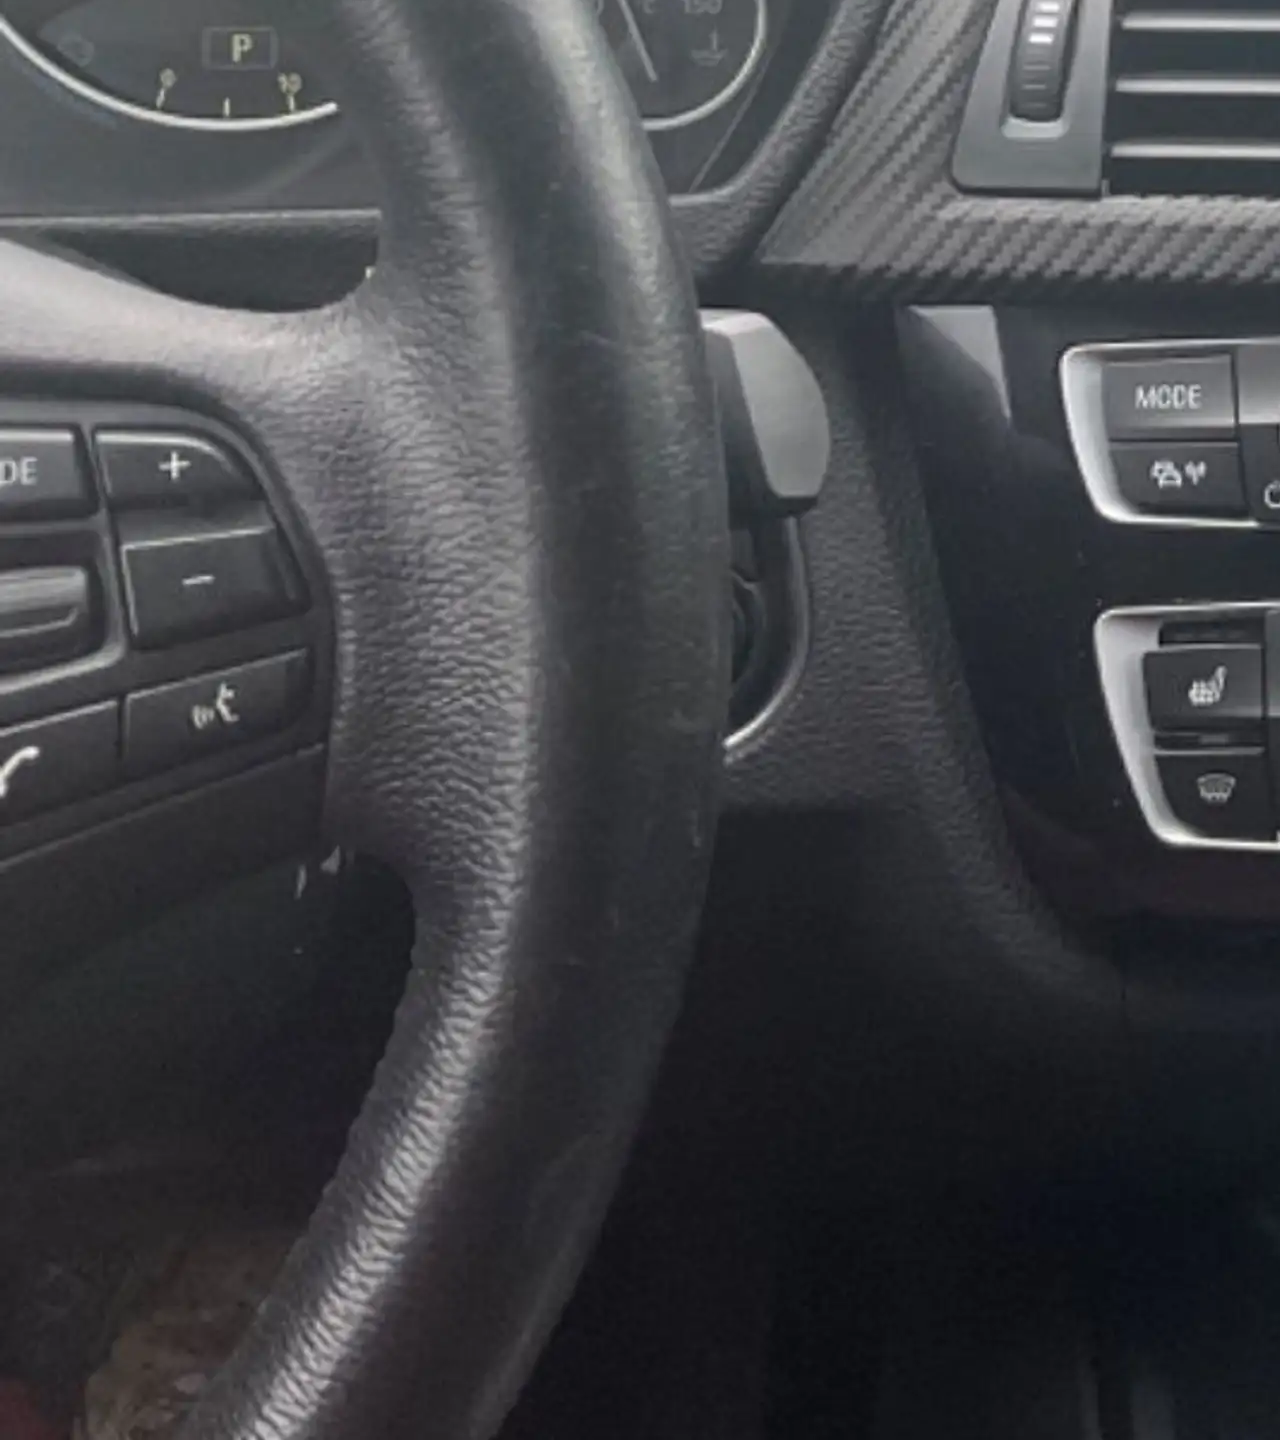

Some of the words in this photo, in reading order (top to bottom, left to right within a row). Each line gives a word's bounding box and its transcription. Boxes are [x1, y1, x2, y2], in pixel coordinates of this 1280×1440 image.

[231, 33, 253, 62] P
[1134, 384, 1202, 409] MODE
[0, 456, 38, 485] DE
